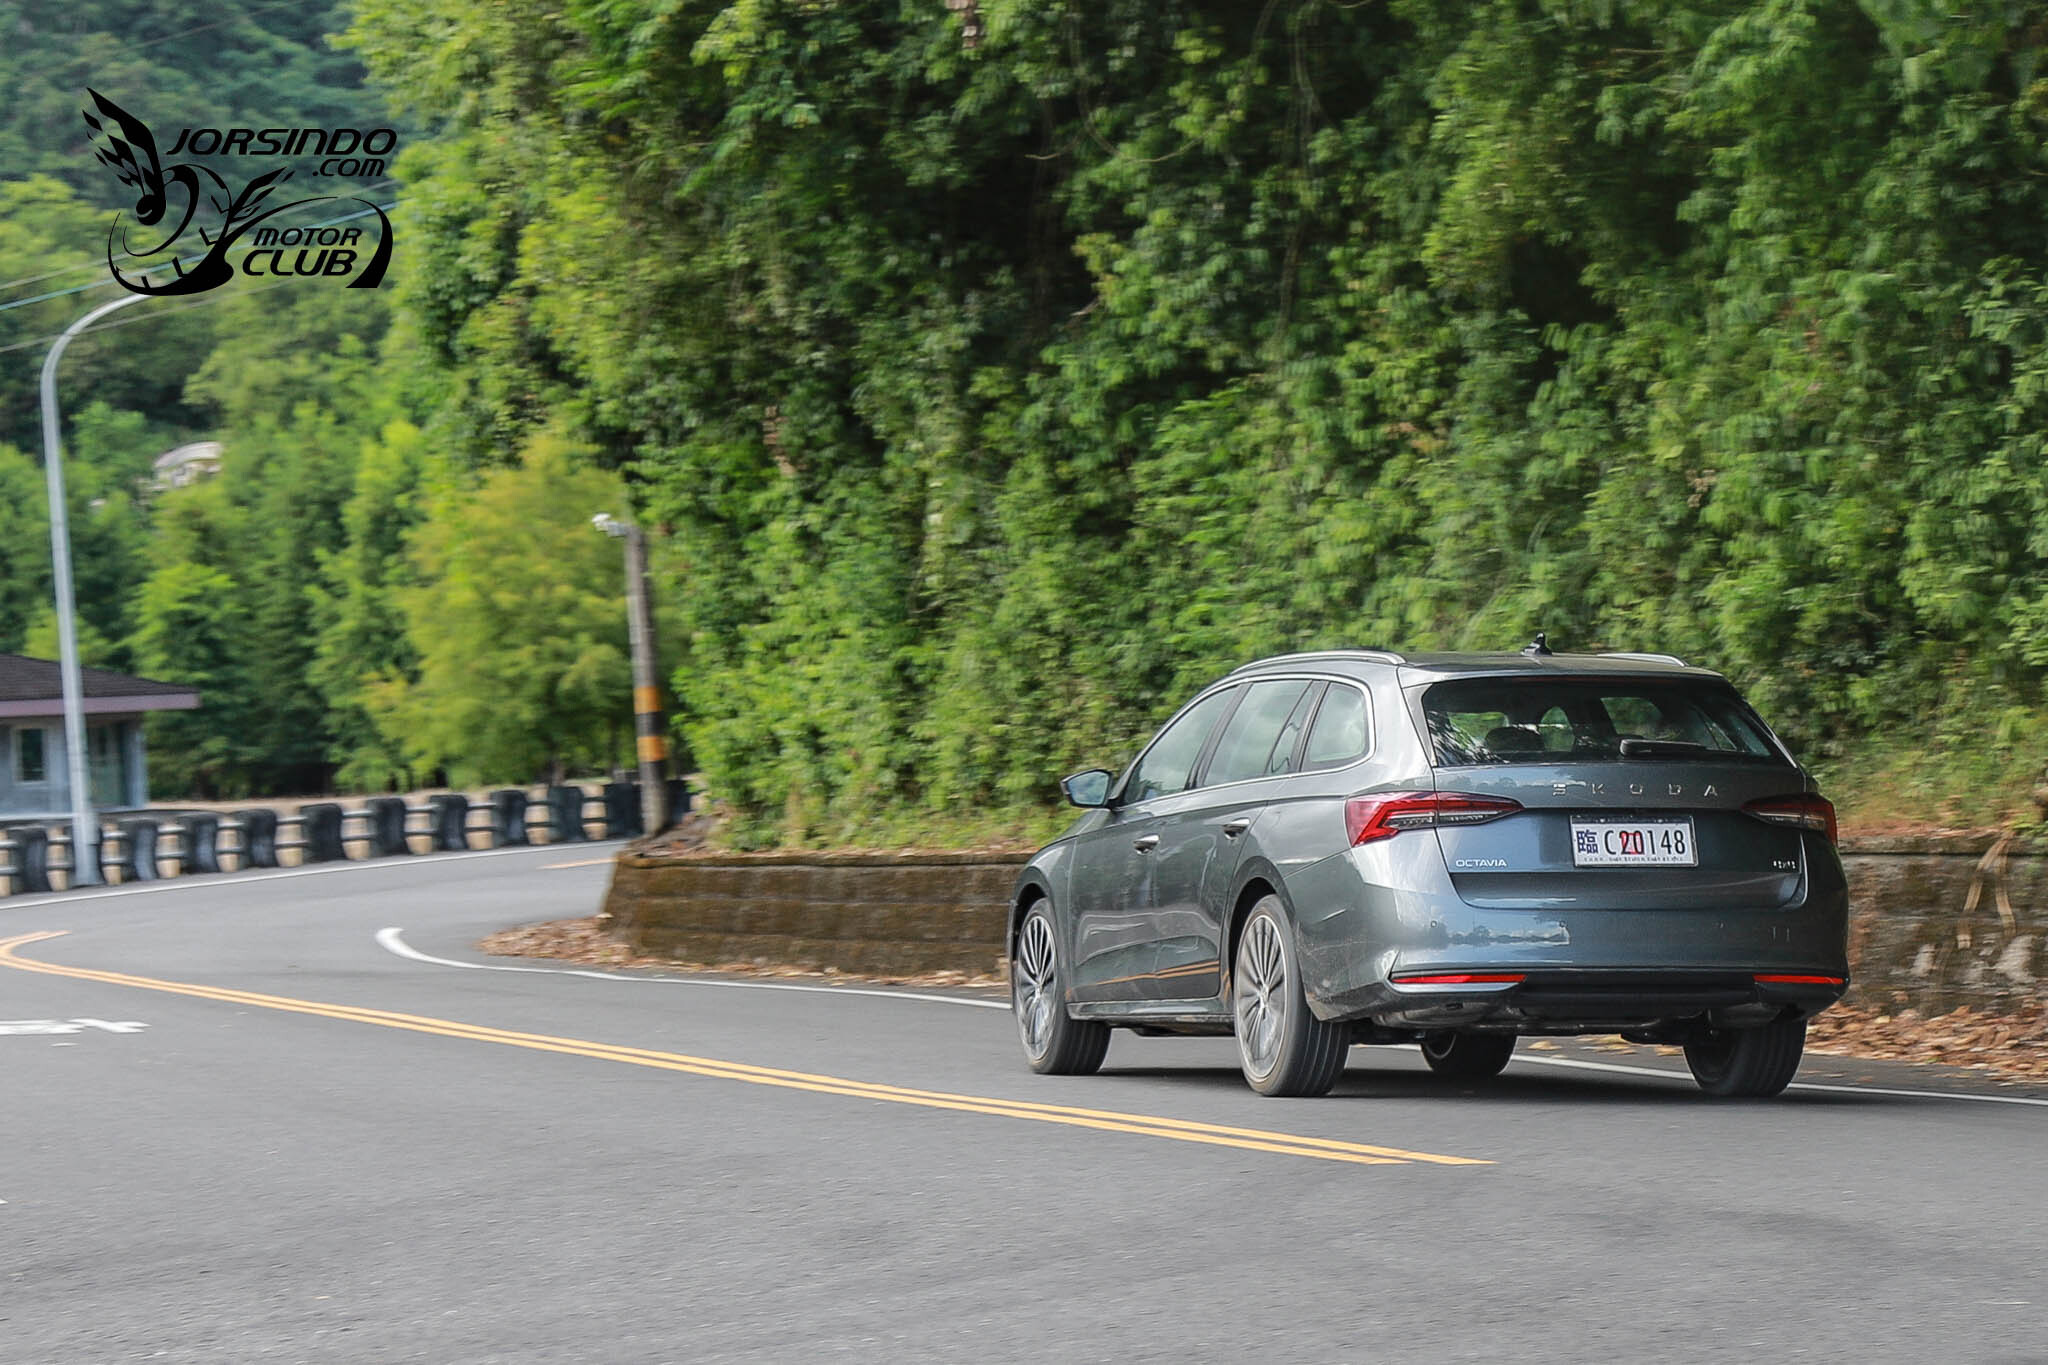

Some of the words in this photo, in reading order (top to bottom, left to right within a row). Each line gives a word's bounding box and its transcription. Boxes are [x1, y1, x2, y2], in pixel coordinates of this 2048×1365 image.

[1575, 828, 1599, 855] 臨
[1604, 829, 1686, 856] C20148
[1455, 859, 1508, 868] OCTAVIA
